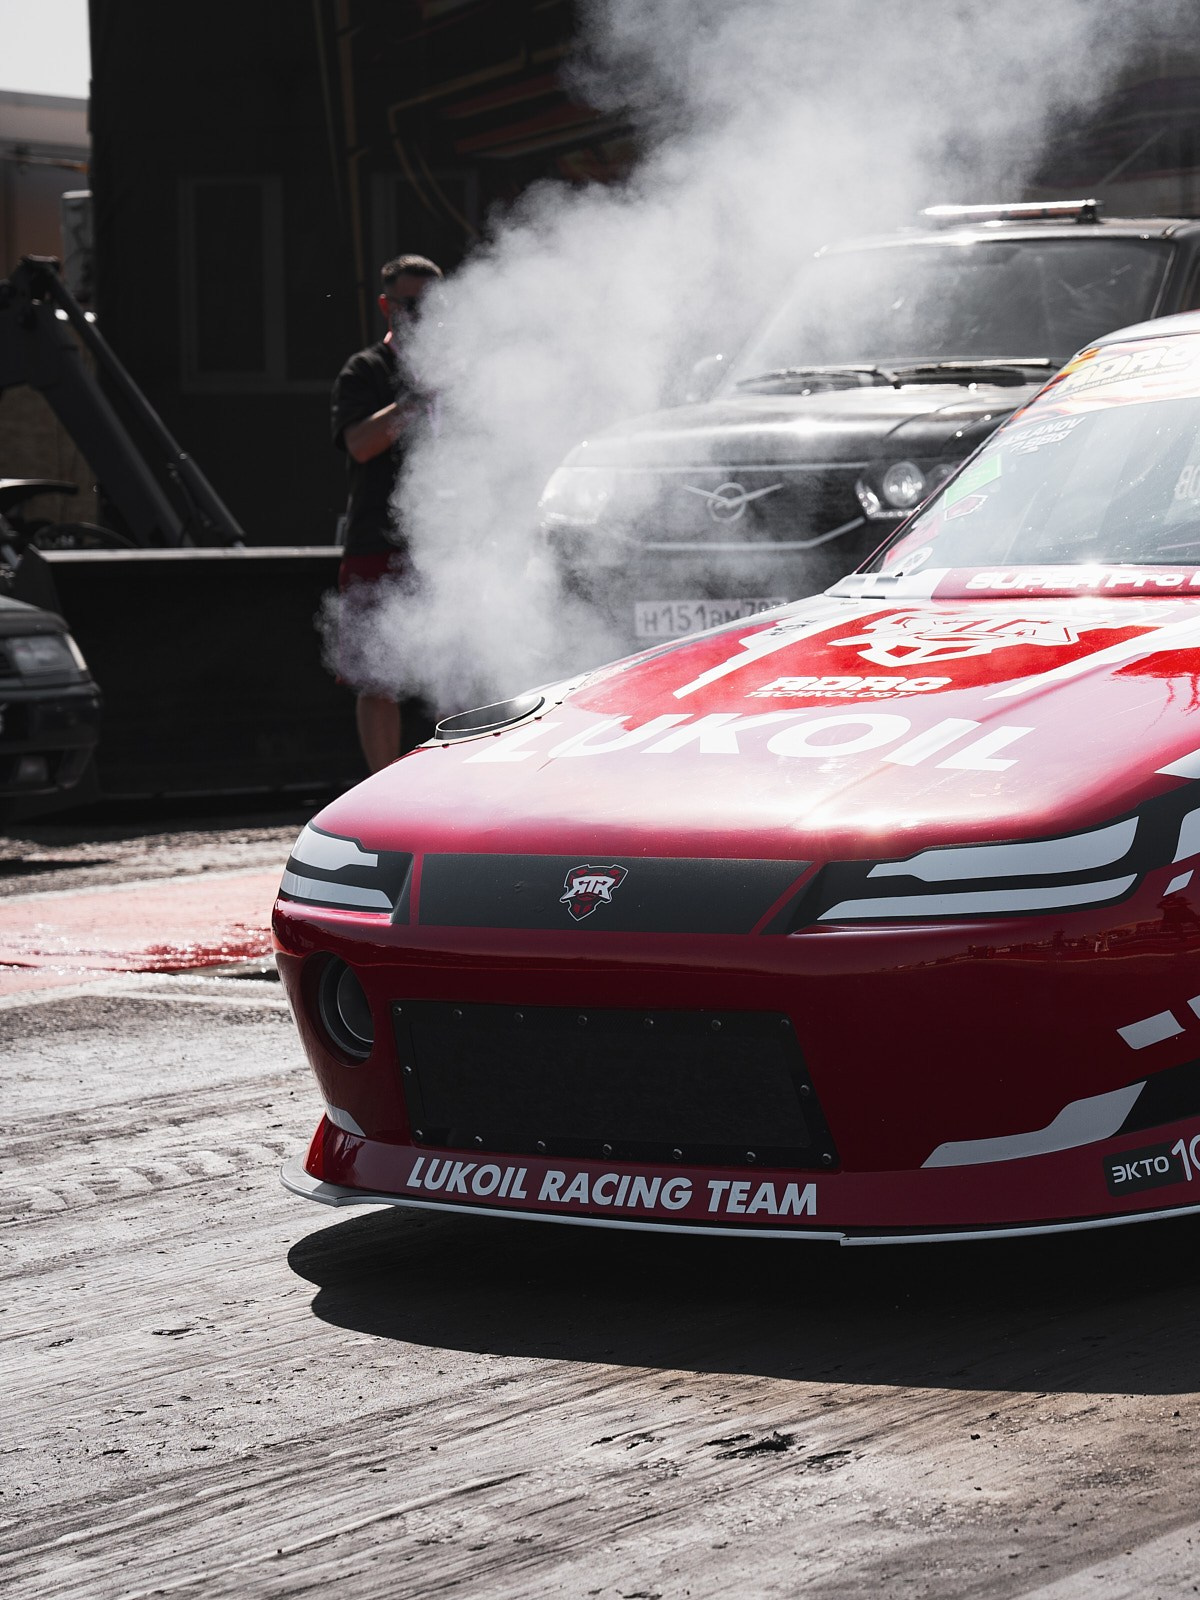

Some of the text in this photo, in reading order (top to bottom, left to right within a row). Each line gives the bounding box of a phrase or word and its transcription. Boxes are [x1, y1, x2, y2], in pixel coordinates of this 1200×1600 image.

[965, 571, 1098, 591] SUPER
[1105, 570, 1184, 588] Pro
[757, 676, 953, 691] RDRC
[462, 713, 1036, 772] LUKOIL
[1112, 1156, 1170, 1184] ЭКТО
[406, 1156, 818, 1216] LUKOIL RACING TEAM
